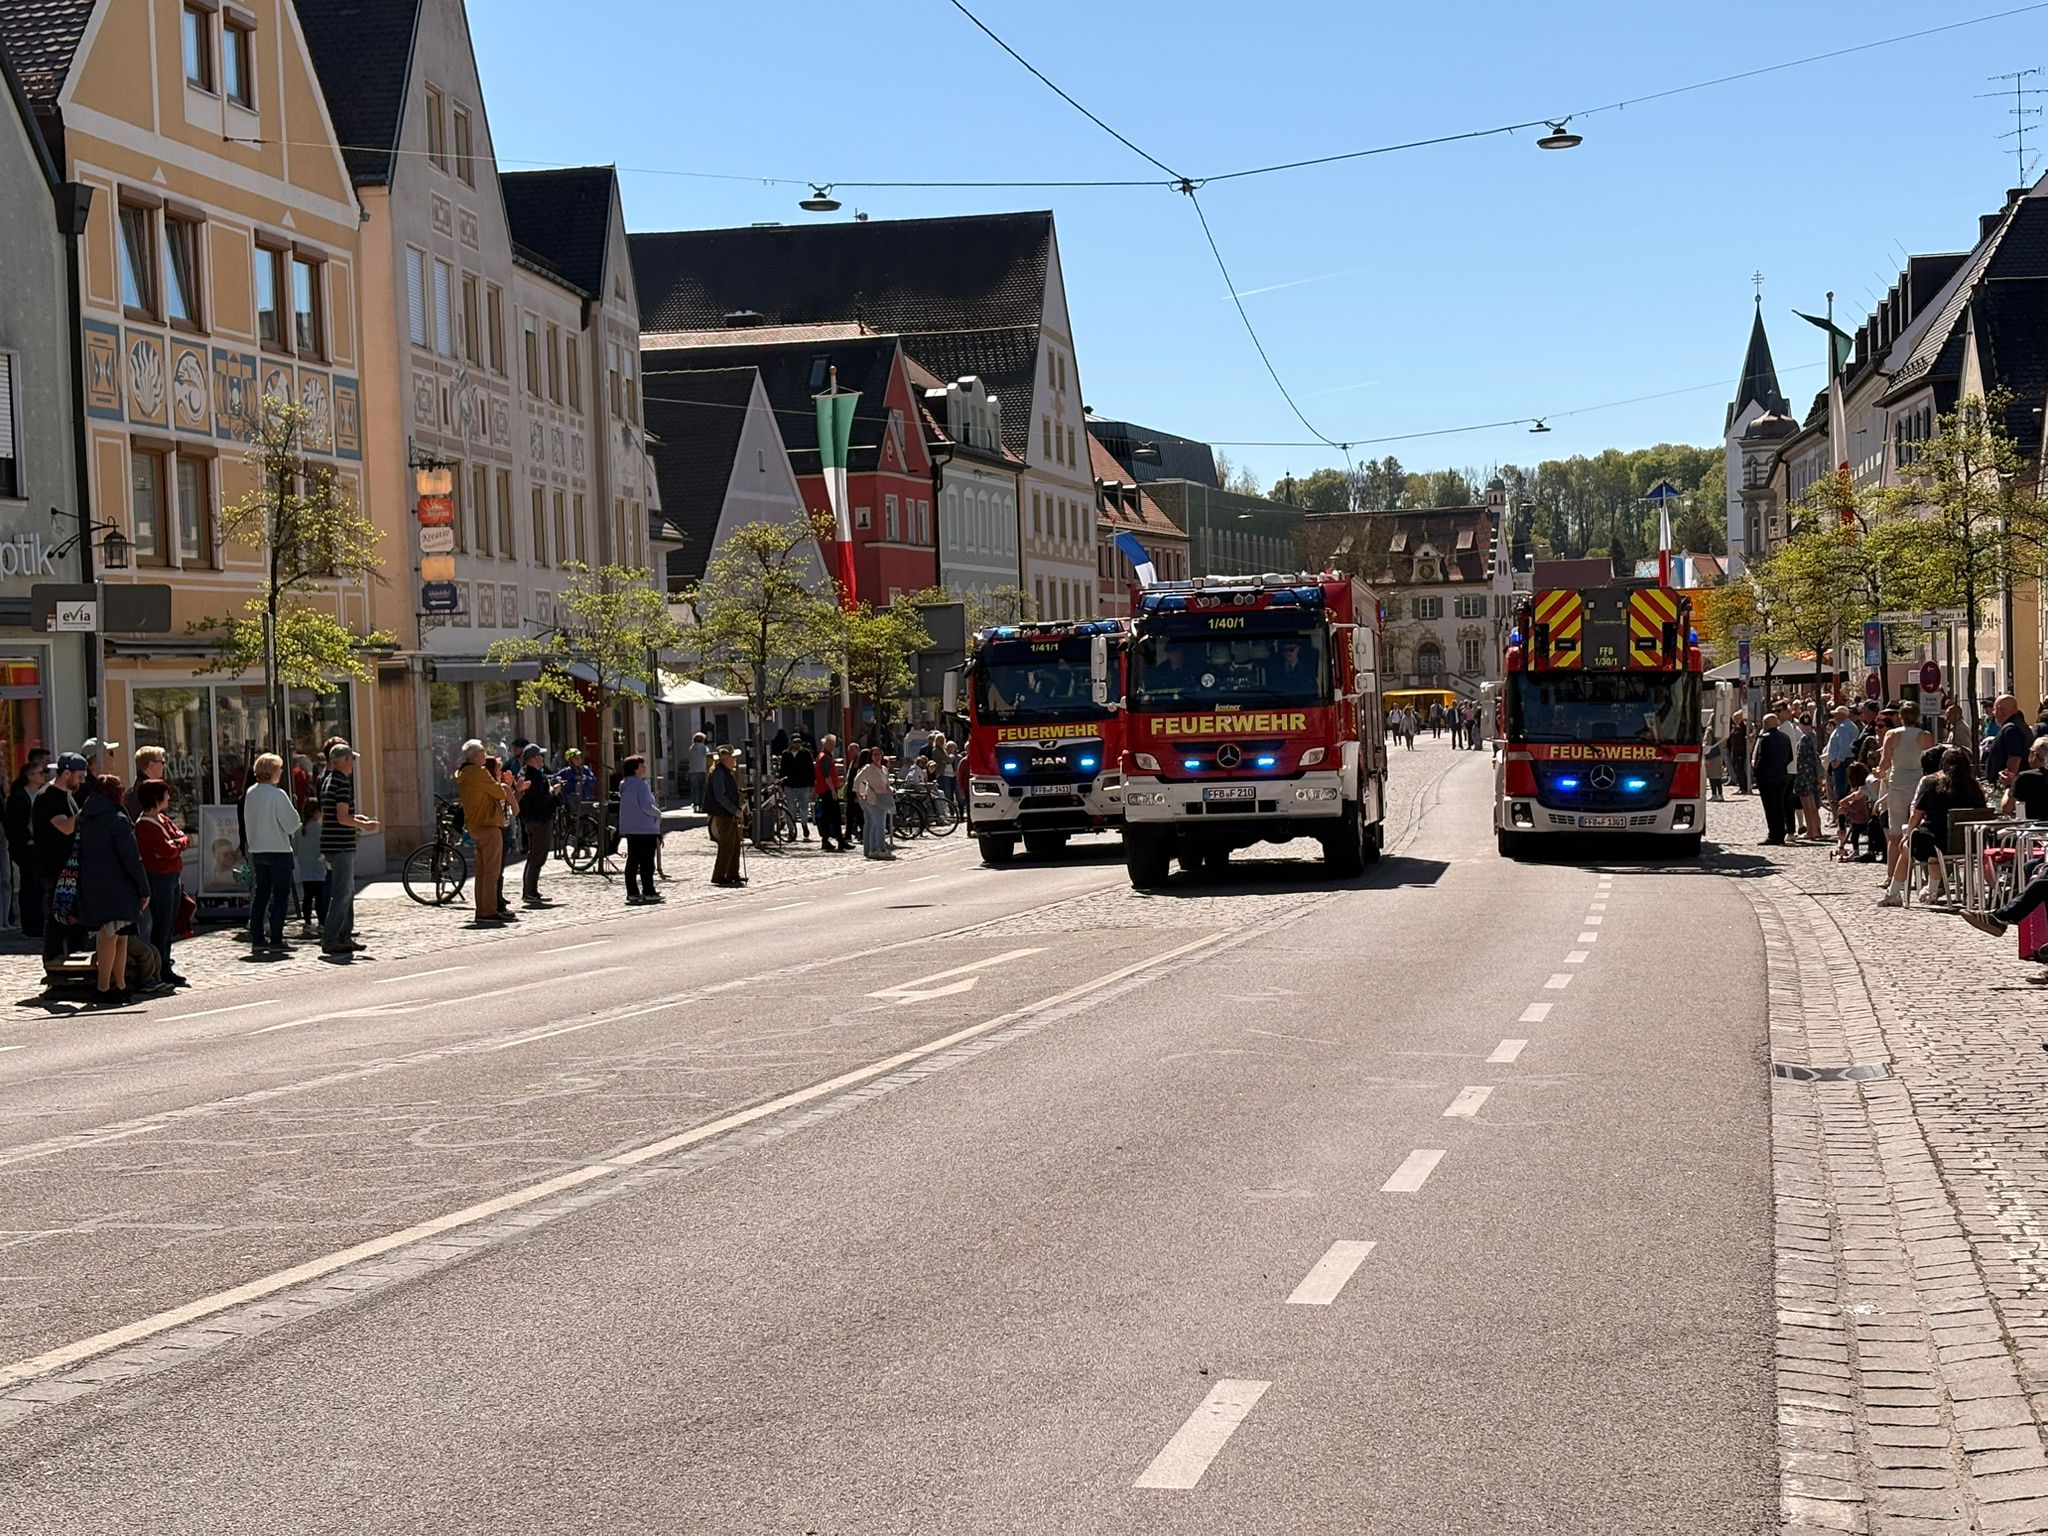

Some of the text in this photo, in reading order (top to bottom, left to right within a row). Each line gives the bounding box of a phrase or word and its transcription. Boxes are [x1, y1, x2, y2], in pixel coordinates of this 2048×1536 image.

[1208, 616, 1244, 629] 1/40/1
[1030, 643, 1059, 652] 1/41/1
[1151, 713, 1307, 735] FEUERWEHR
[998, 723, 1099, 741] FEUERWEHR
[1550, 746, 1657, 759] FEUERWEHR
[1031, 756, 1067, 766] MAN
